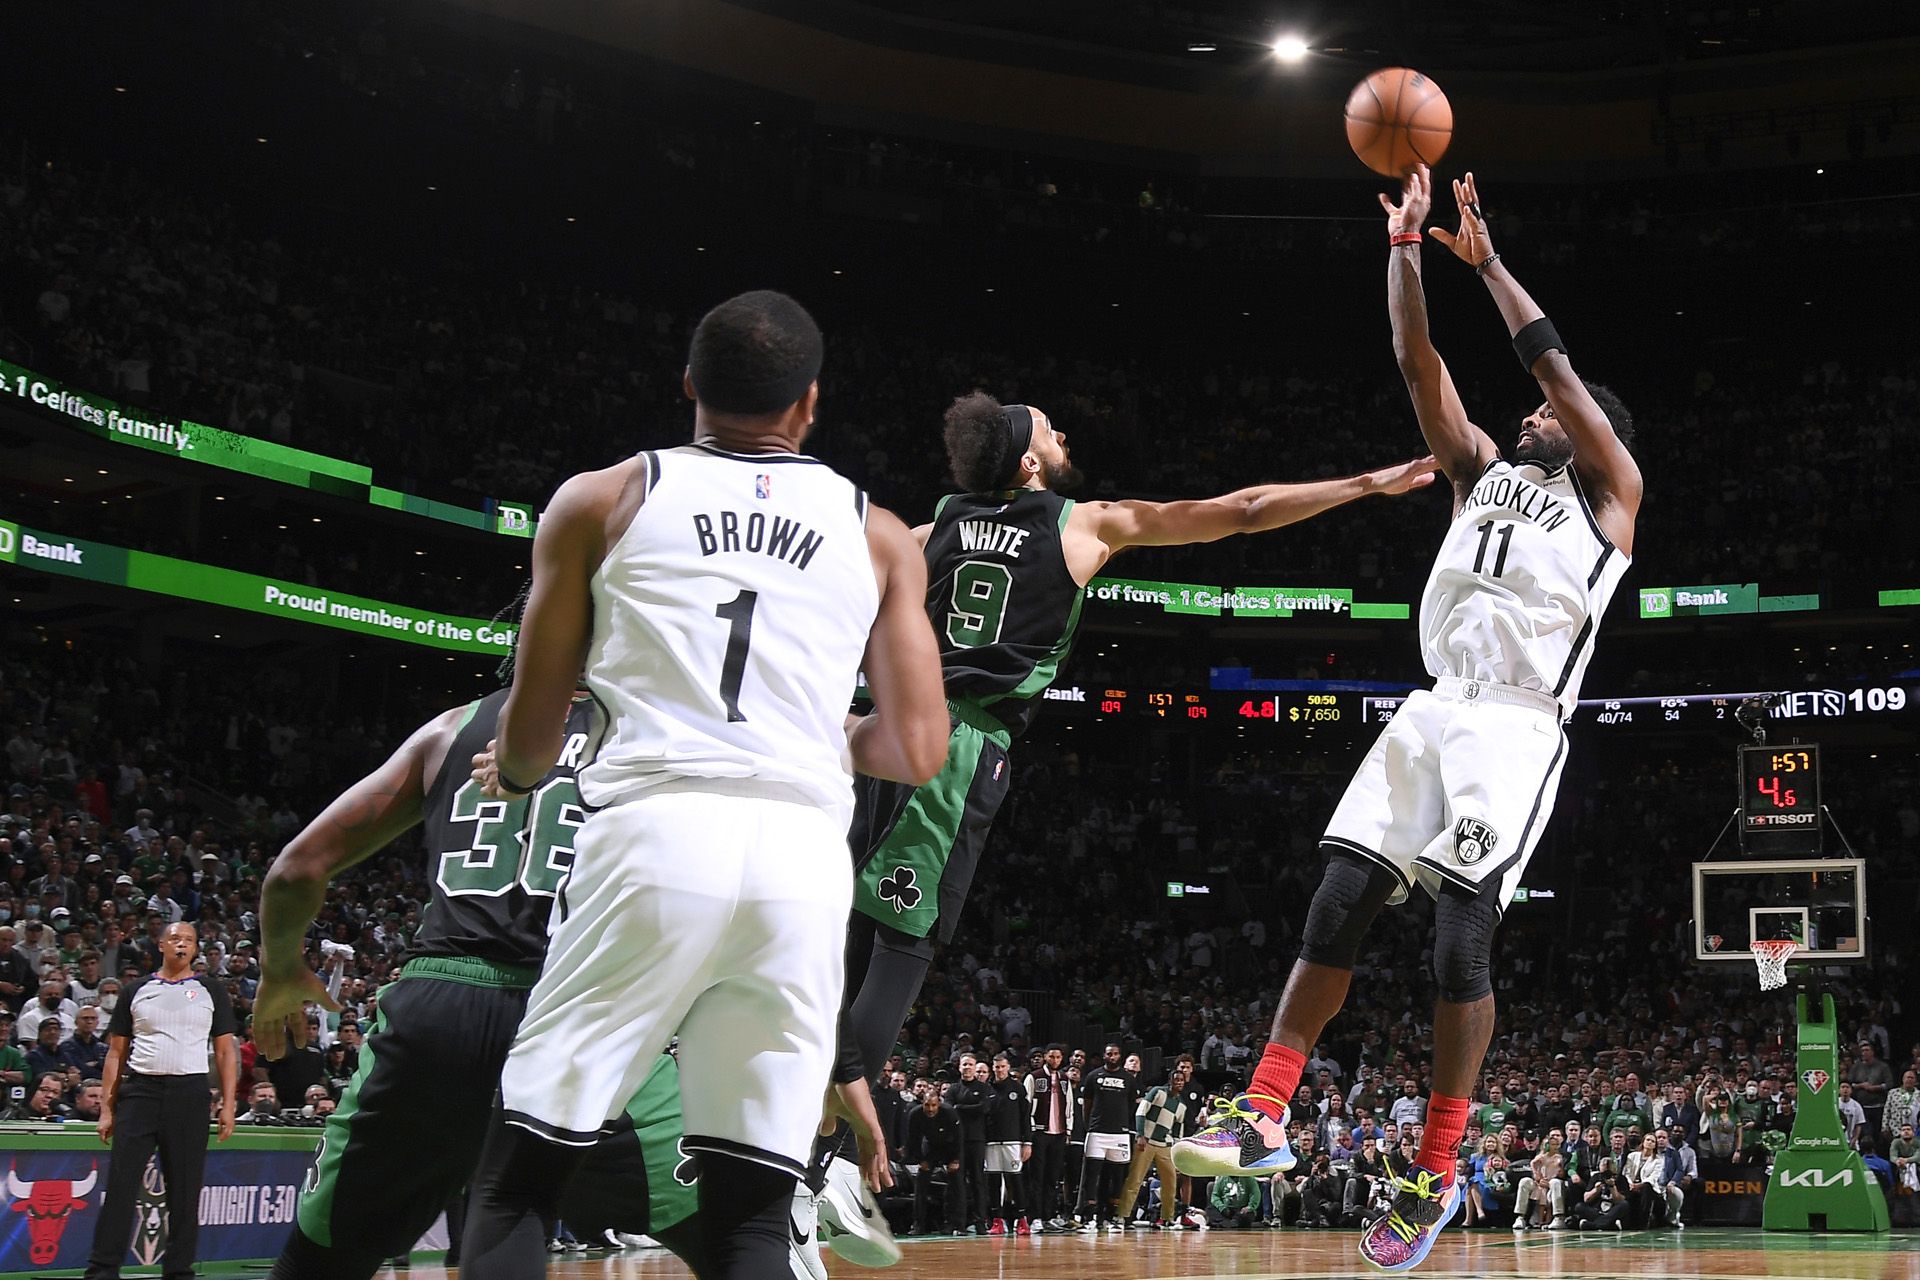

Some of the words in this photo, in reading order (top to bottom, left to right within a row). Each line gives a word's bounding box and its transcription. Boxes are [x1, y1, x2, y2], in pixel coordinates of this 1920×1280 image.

[31, 382, 105, 427] Celtics
[108, 410, 194, 450] family.
[498, 506, 527, 530] TD
[693, 511, 824, 571] BROWN
[958, 521, 1031, 558] WHITE
[22, 534, 83, 564] Bank
[1472, 520, 1515, 578] 11
[946, 560, 1013, 650] 9
[1098, 584, 1121, 600] of
[1194, 591, 1270, 609] Celtics
[1274, 593, 1349, 613] family.
[1640, 593, 1669, 612] TD
[1677, 589, 1728, 606] Bank
[265, 586, 327, 614] Proud
[331, 602, 412, 631] member
[415, 618, 435, 636] of
[438, 622, 472, 641] the
[476, 626, 518, 647] Cel
[715, 589, 758, 722] 1
[1101, 701, 1121, 713] 109
[1149, 693, 1173, 706] 1:57
[1307, 695, 1336, 705] 50/50
[1374, 700, 1396, 709] REB
[1605, 701, 1621, 710] FG
[1660, 699, 1688, 708] FG%
[1774, 692, 1840, 718] NETS
[1848, 687, 1906, 712] 109
[1158, 709, 1165, 717] 4
[1188, 706, 1207, 718] 109
[1238, 701, 1275, 718] 4.8
[1289, 706, 1300, 722] $
[1303, 708, 1340, 723] 7,650
[1378, 711, 1393, 722] 28
[1597, 711, 1632, 724] 40/74
[1665, 710, 1680, 721] 54
[1716, 708, 1724, 719] 2
[1772, 752, 1809, 772] 1:57
[1758, 777, 1796, 807] 4.6
[1766, 813, 1816, 825] TISSOT
[436, 777, 583, 897] 36
[1458, 819, 1496, 851] NETS
[1793, 1137, 1820, 1147] Google
[1781, 1169, 1853, 1186] KIA
[1705, 1181, 1762, 1195] RDEN
[199, 1186, 258, 1226] ONIGHT
[258, 1185, 296, 1224] 6:30
